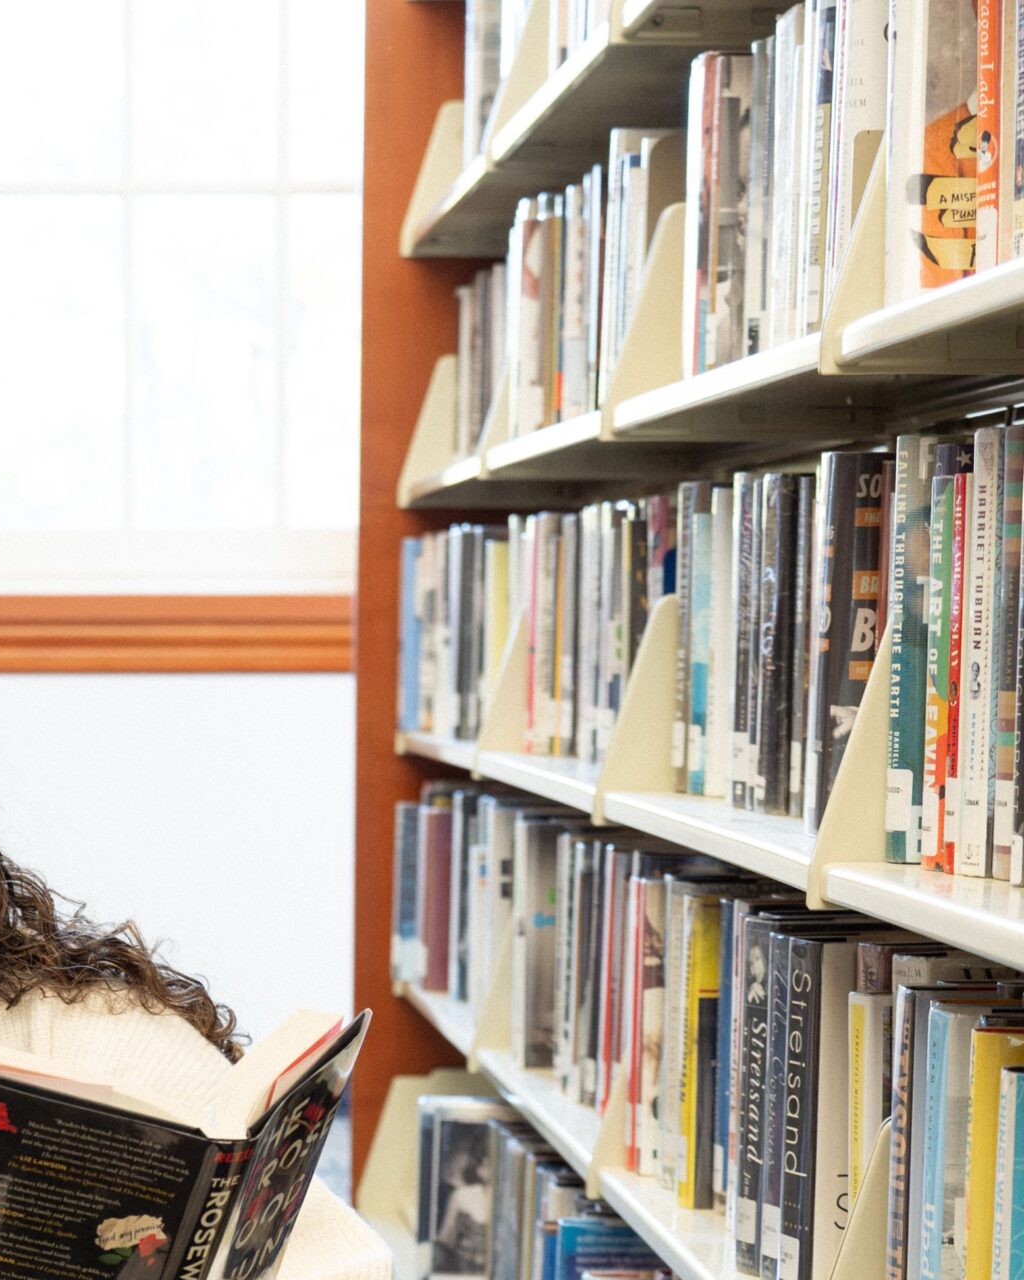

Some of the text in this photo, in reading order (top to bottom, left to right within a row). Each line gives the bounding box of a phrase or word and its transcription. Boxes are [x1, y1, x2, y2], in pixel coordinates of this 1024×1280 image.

[978, 61, 995, 118] Lady
[895, 450, 910, 524] FALLING
[932, 520, 945, 565] THE
[972, 484, 987, 651] HARRIET TUBMAN
[892, 532, 907, 614] THROUGH
[950, 495, 964, 676] SHE CAME TO SLAY
[929, 577, 945, 637] ART
[1004, 573, 1015, 684] HARRIET TUBMAN
[891, 621, 902, 654] THE
[928, 648, 939, 676] OF
[889, 663, 902, 718] EARTH
[746, 1017, 769, 1165] Streisand
[784, 968, 812, 1177] Streisand
[214, 1147, 253, 1164] REED
[998, 1093, 1009, 1173] THINGS
[211, 1174, 240, 1189] THE
[996, 1179, 1005, 1215] WE
